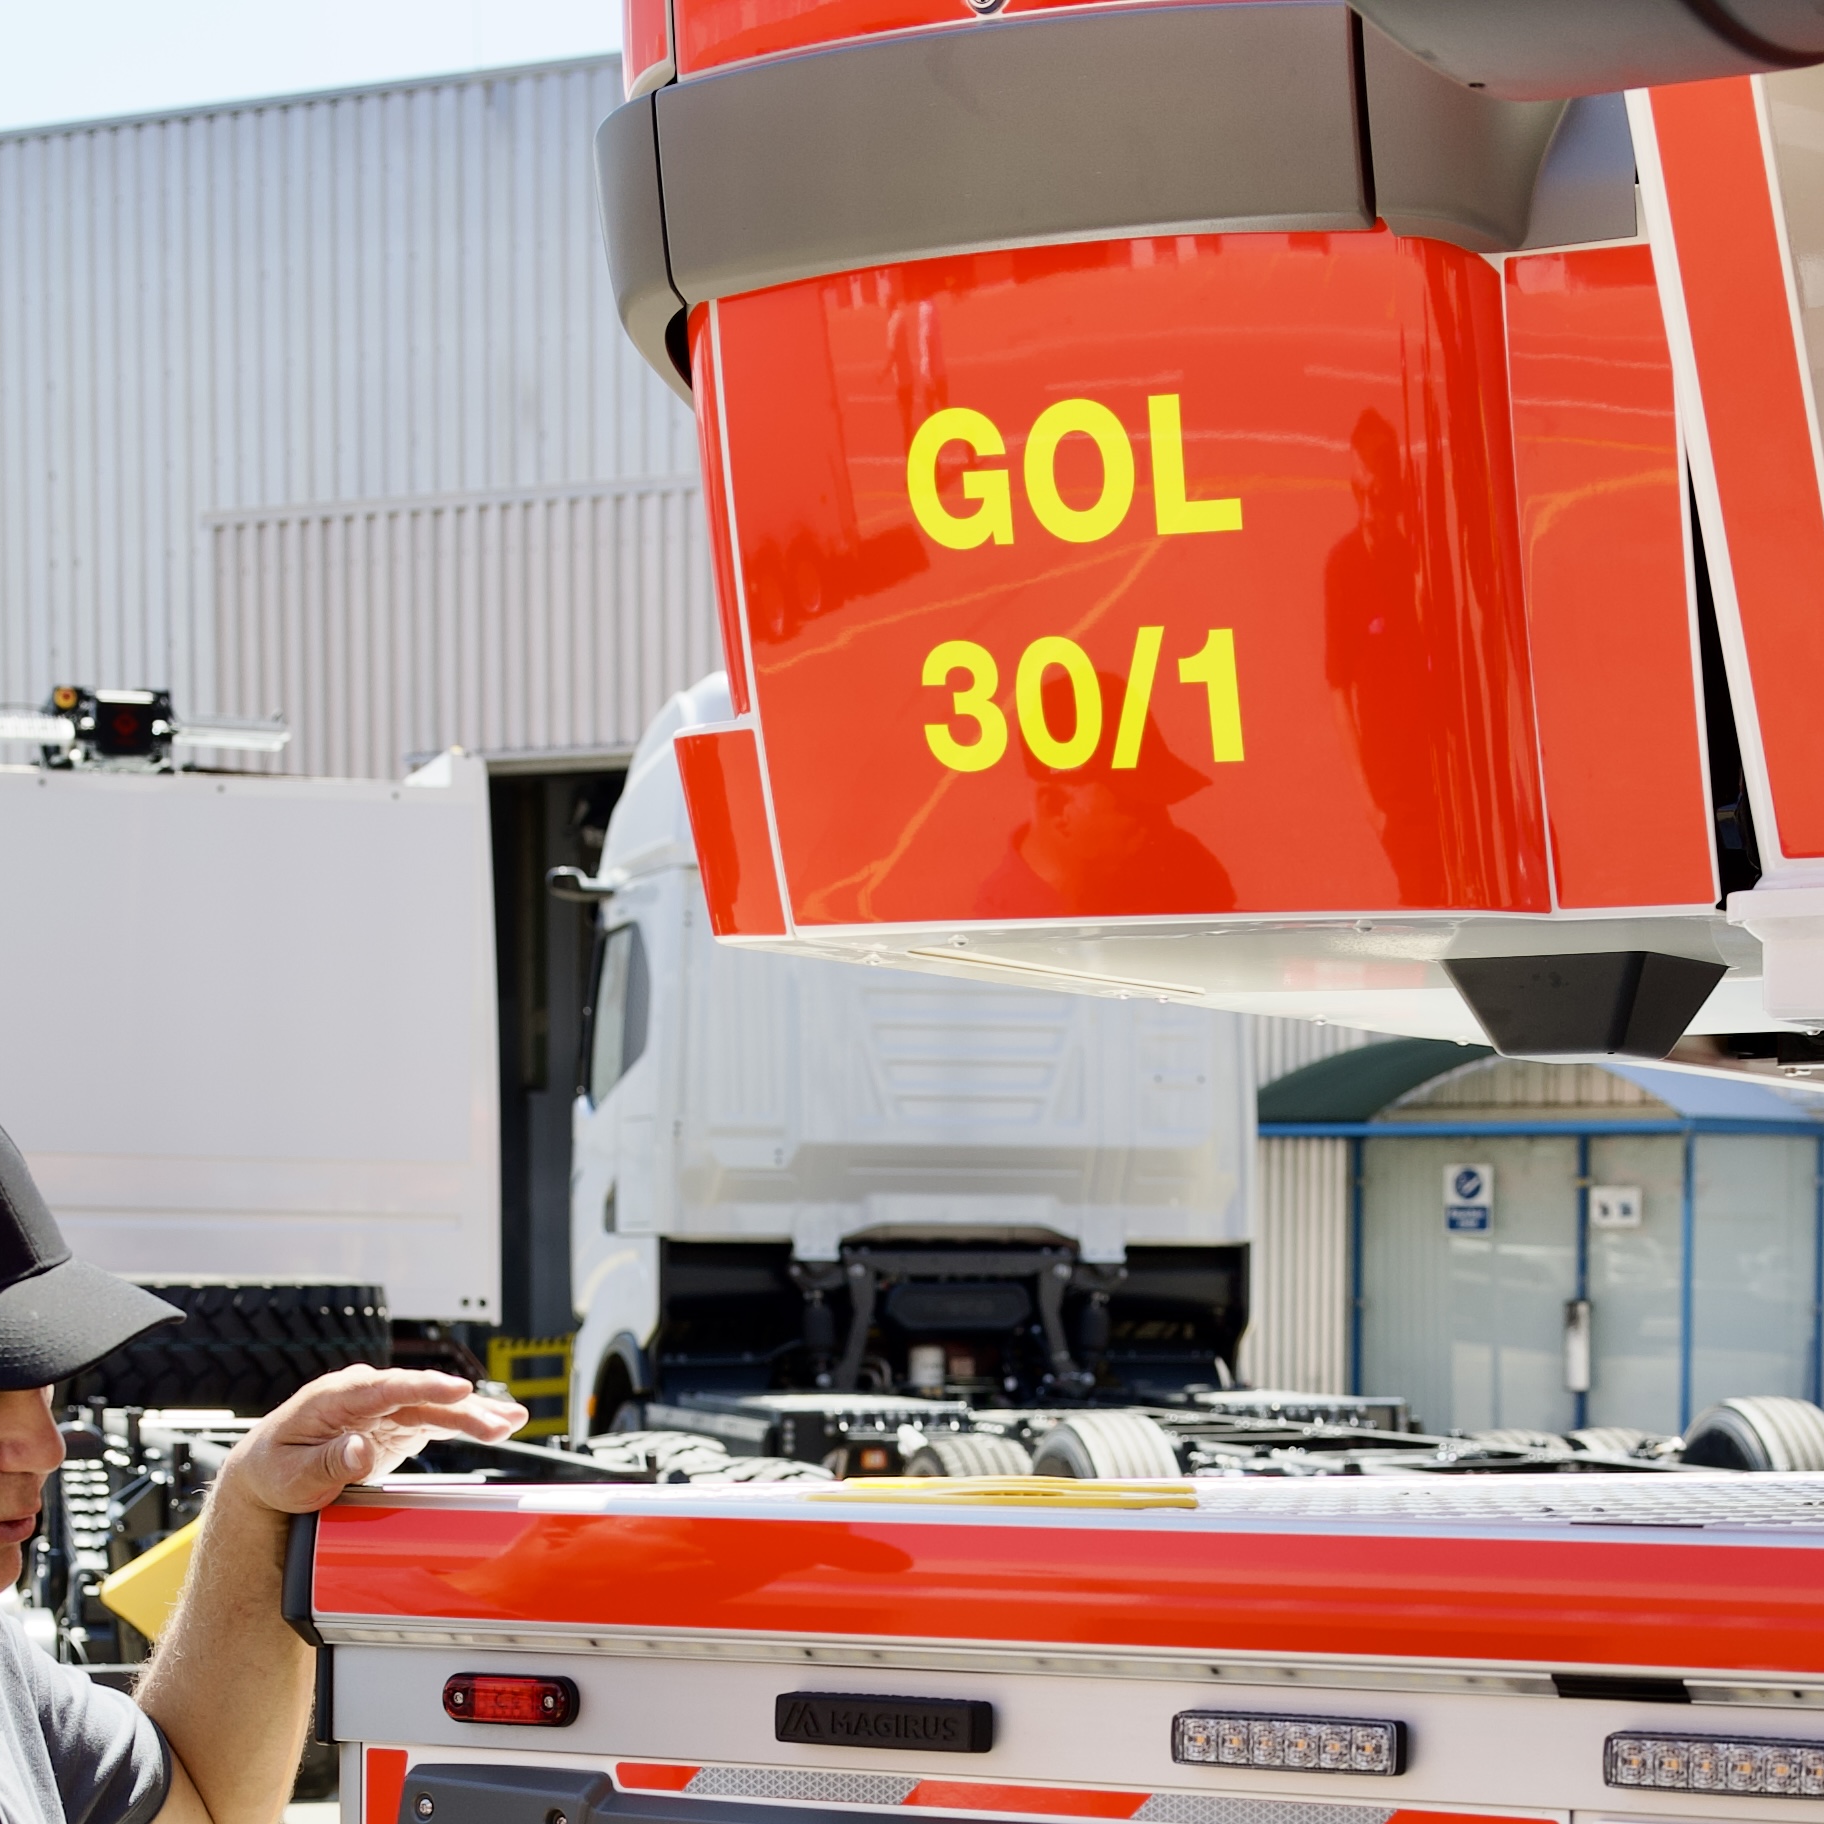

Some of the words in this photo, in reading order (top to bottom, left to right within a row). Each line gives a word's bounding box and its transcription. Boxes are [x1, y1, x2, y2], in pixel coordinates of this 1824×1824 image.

[907, 393, 1243, 550] GOL
[921, 625, 1245, 773] 30/1
[829, 1709, 959, 1742] MAGIRUS
